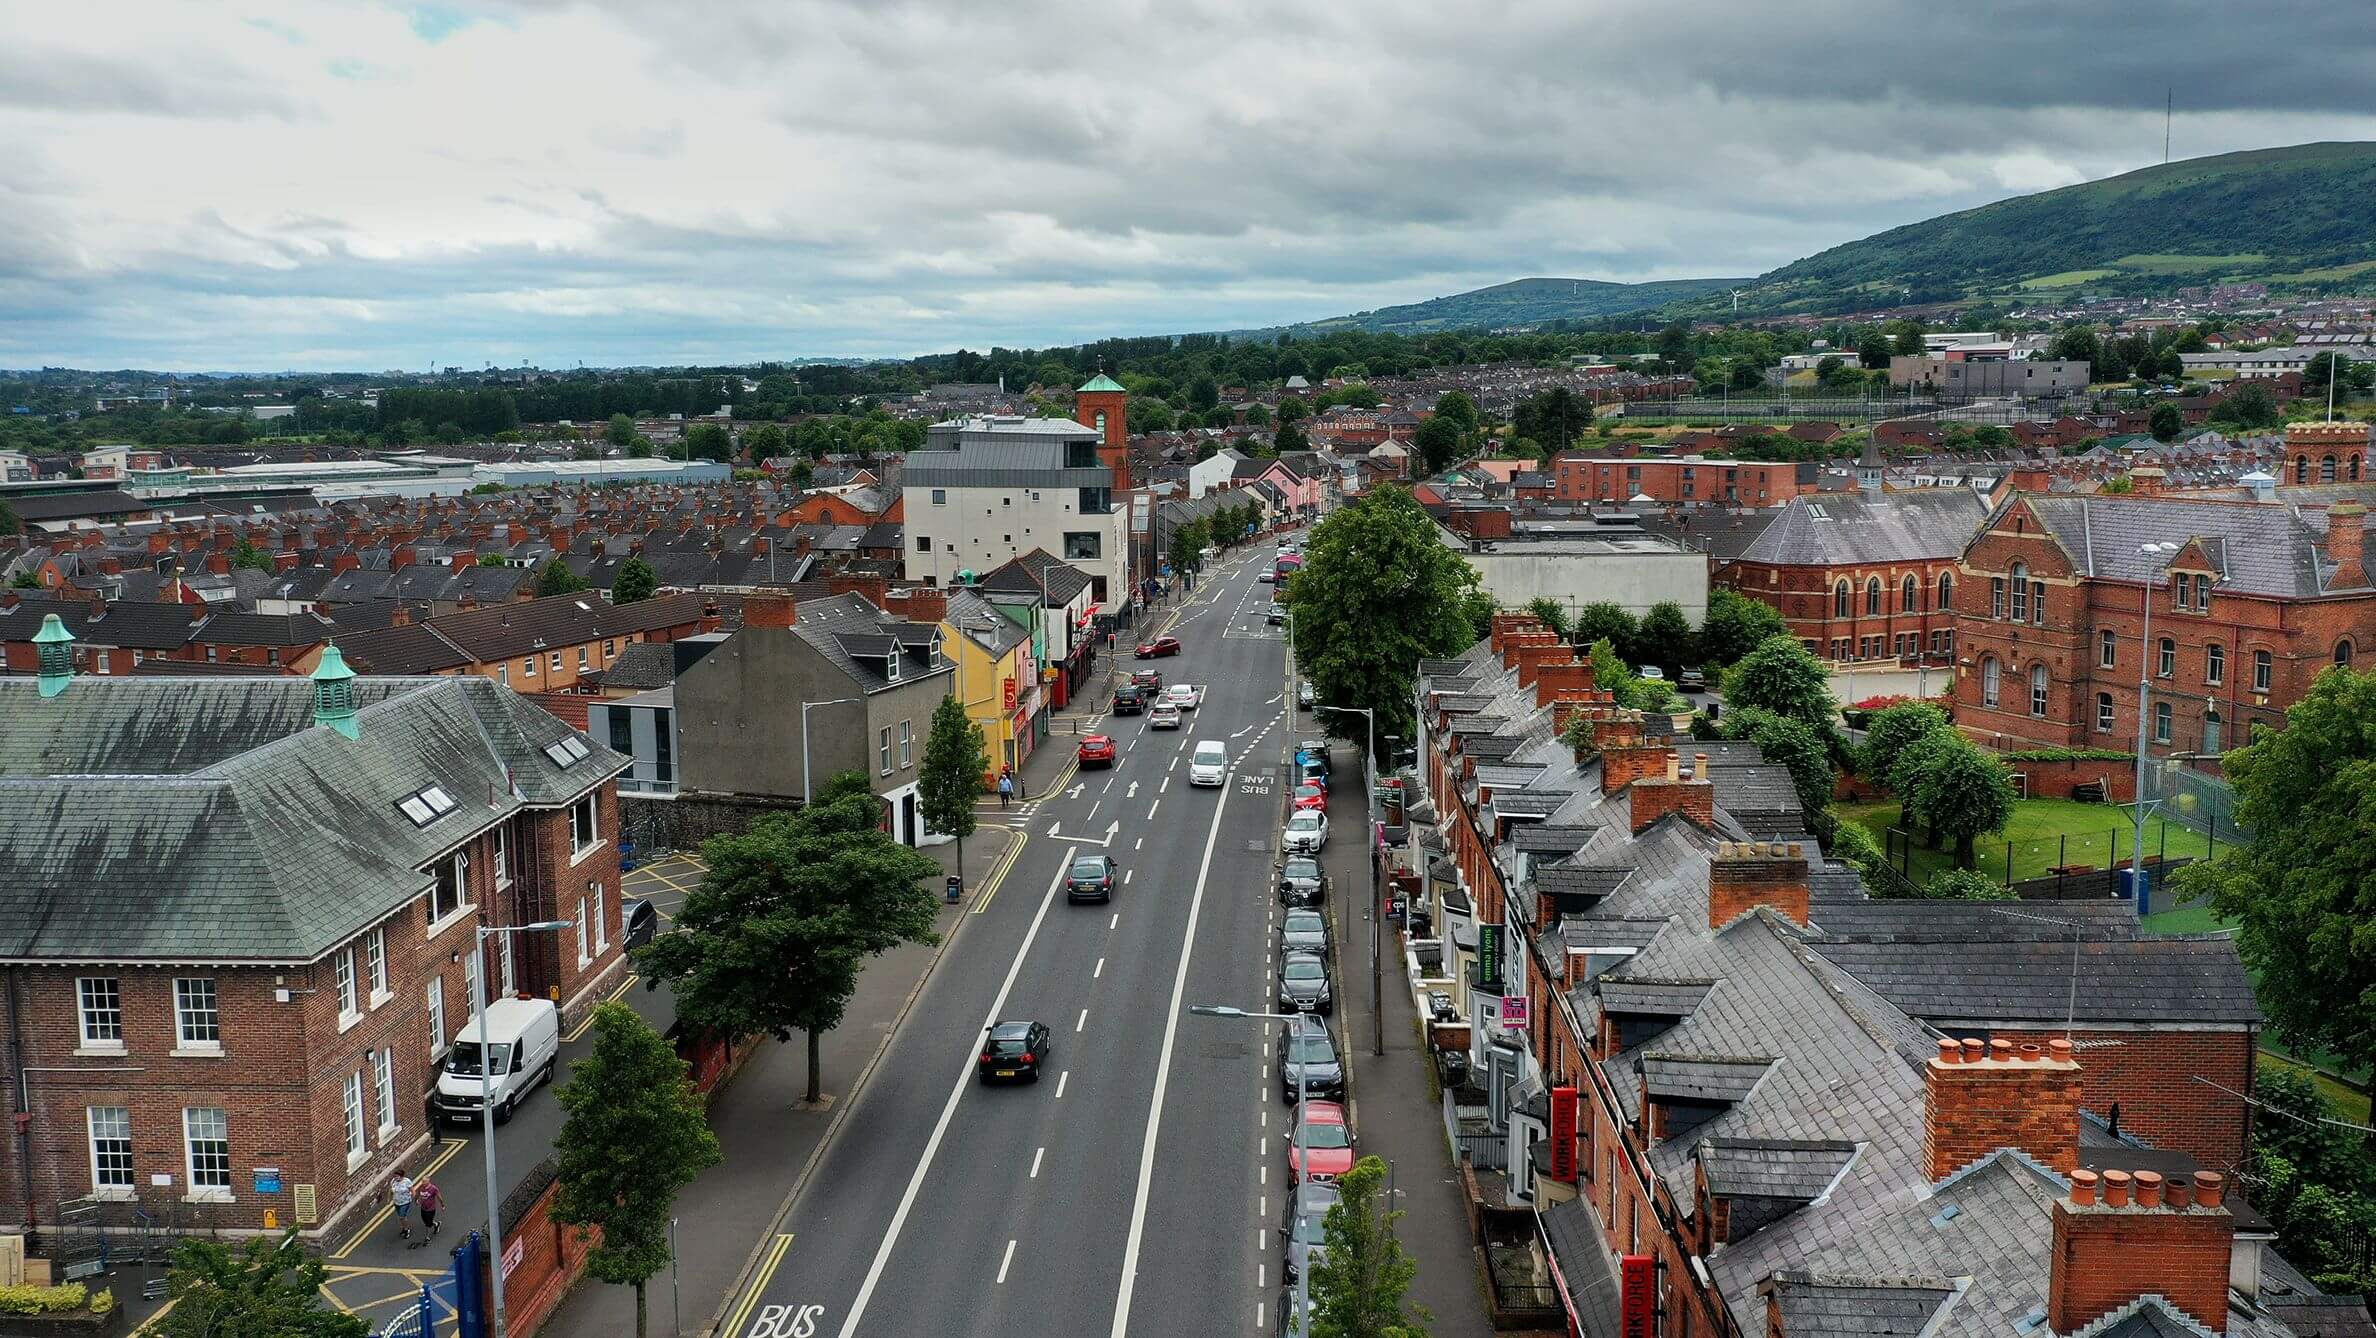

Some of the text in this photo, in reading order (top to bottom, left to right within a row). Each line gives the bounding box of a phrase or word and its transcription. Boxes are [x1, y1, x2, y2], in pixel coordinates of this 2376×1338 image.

[1240, 774, 1274, 785] LANE
[1241, 785, 1269, 795] BUS
[1483, 928, 1493, 982] emma lyons
[1556, 1095, 1570, 1178] WORKFORCE
[747, 1304, 825, 1338] BUS
